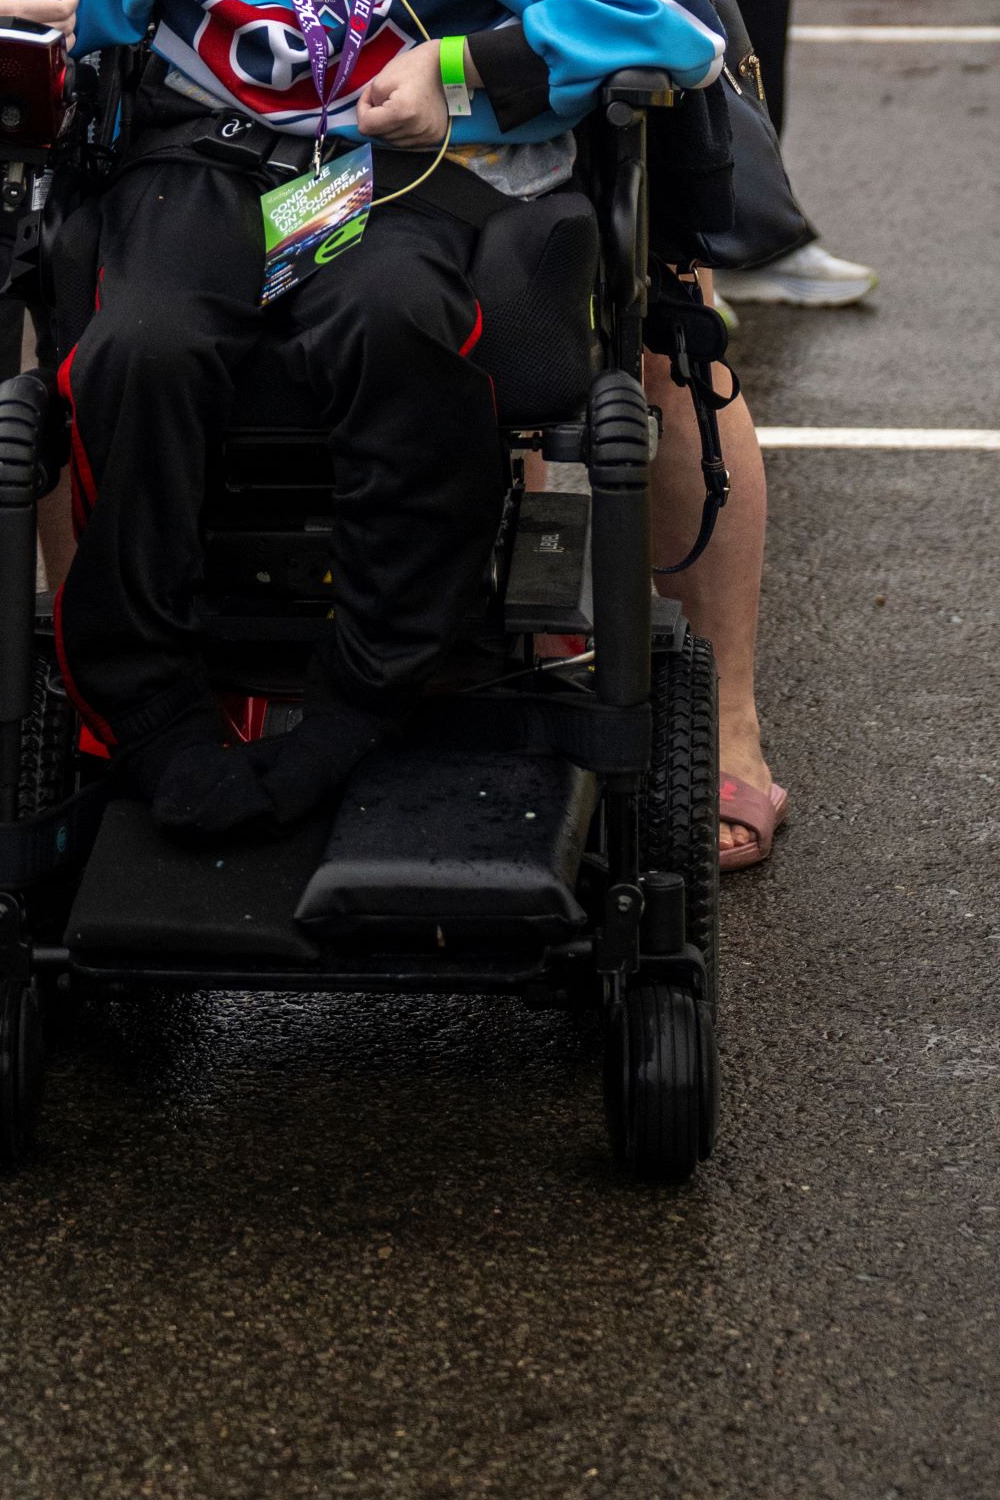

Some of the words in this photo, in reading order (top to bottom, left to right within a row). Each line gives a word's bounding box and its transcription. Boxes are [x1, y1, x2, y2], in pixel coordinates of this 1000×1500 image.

[349, 28, 362, 49] IT
[269, 165, 331, 220] CONDUIRE
[275, 195, 309, 228] POUR
[279, 214, 298, 232] UN
[299, 170, 350, 217] SOURIRE
